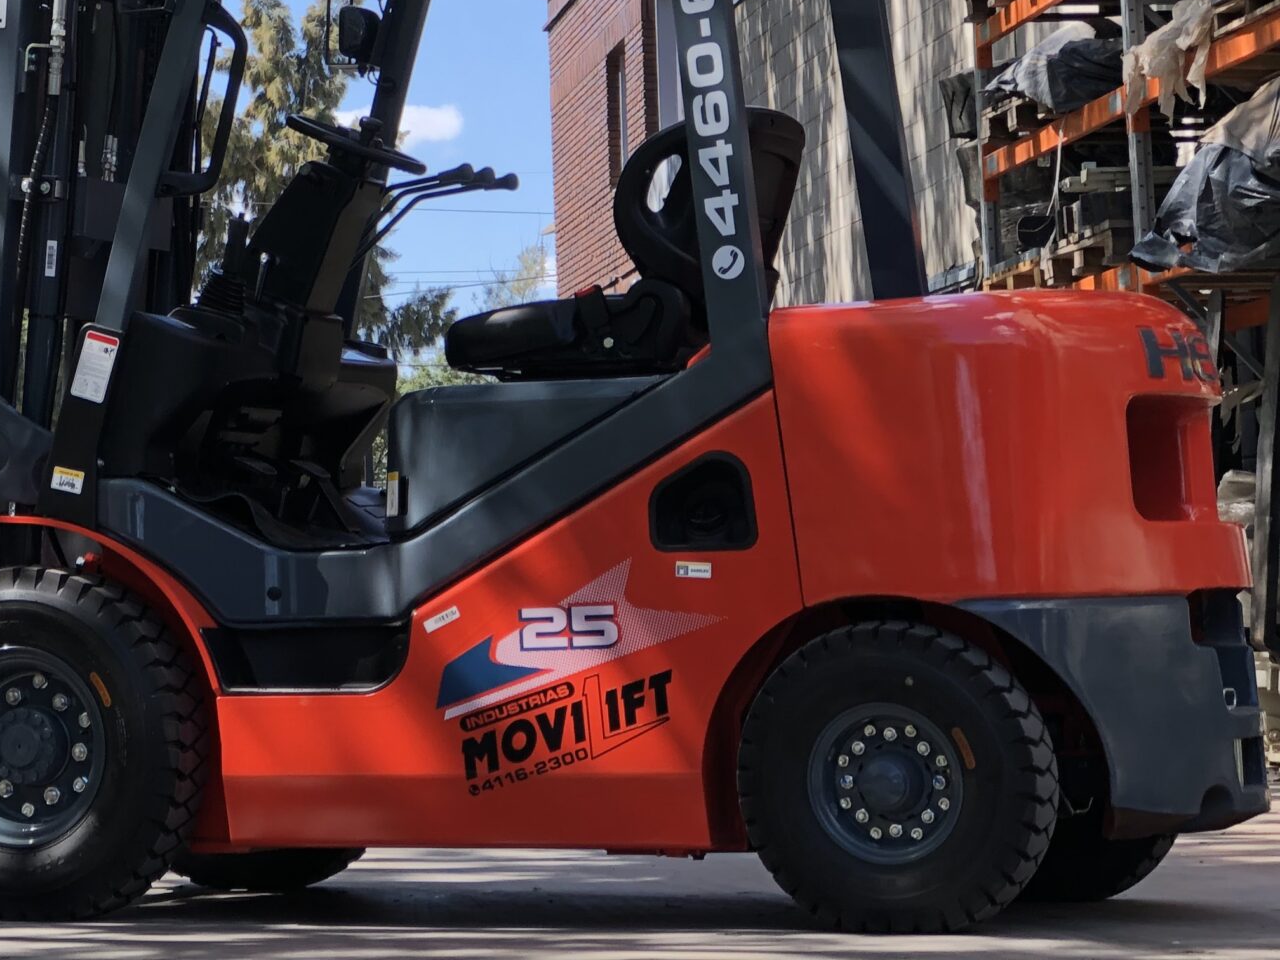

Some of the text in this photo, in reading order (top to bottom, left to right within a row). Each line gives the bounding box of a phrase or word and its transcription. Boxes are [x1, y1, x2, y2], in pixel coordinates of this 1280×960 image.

[518, 605, 619, 651] 25
[461, 669, 673, 780] MOVILIFT
[465, 685, 571, 730] INDUSTRIAS
[482, 747, 590, 793] 4116-2300
